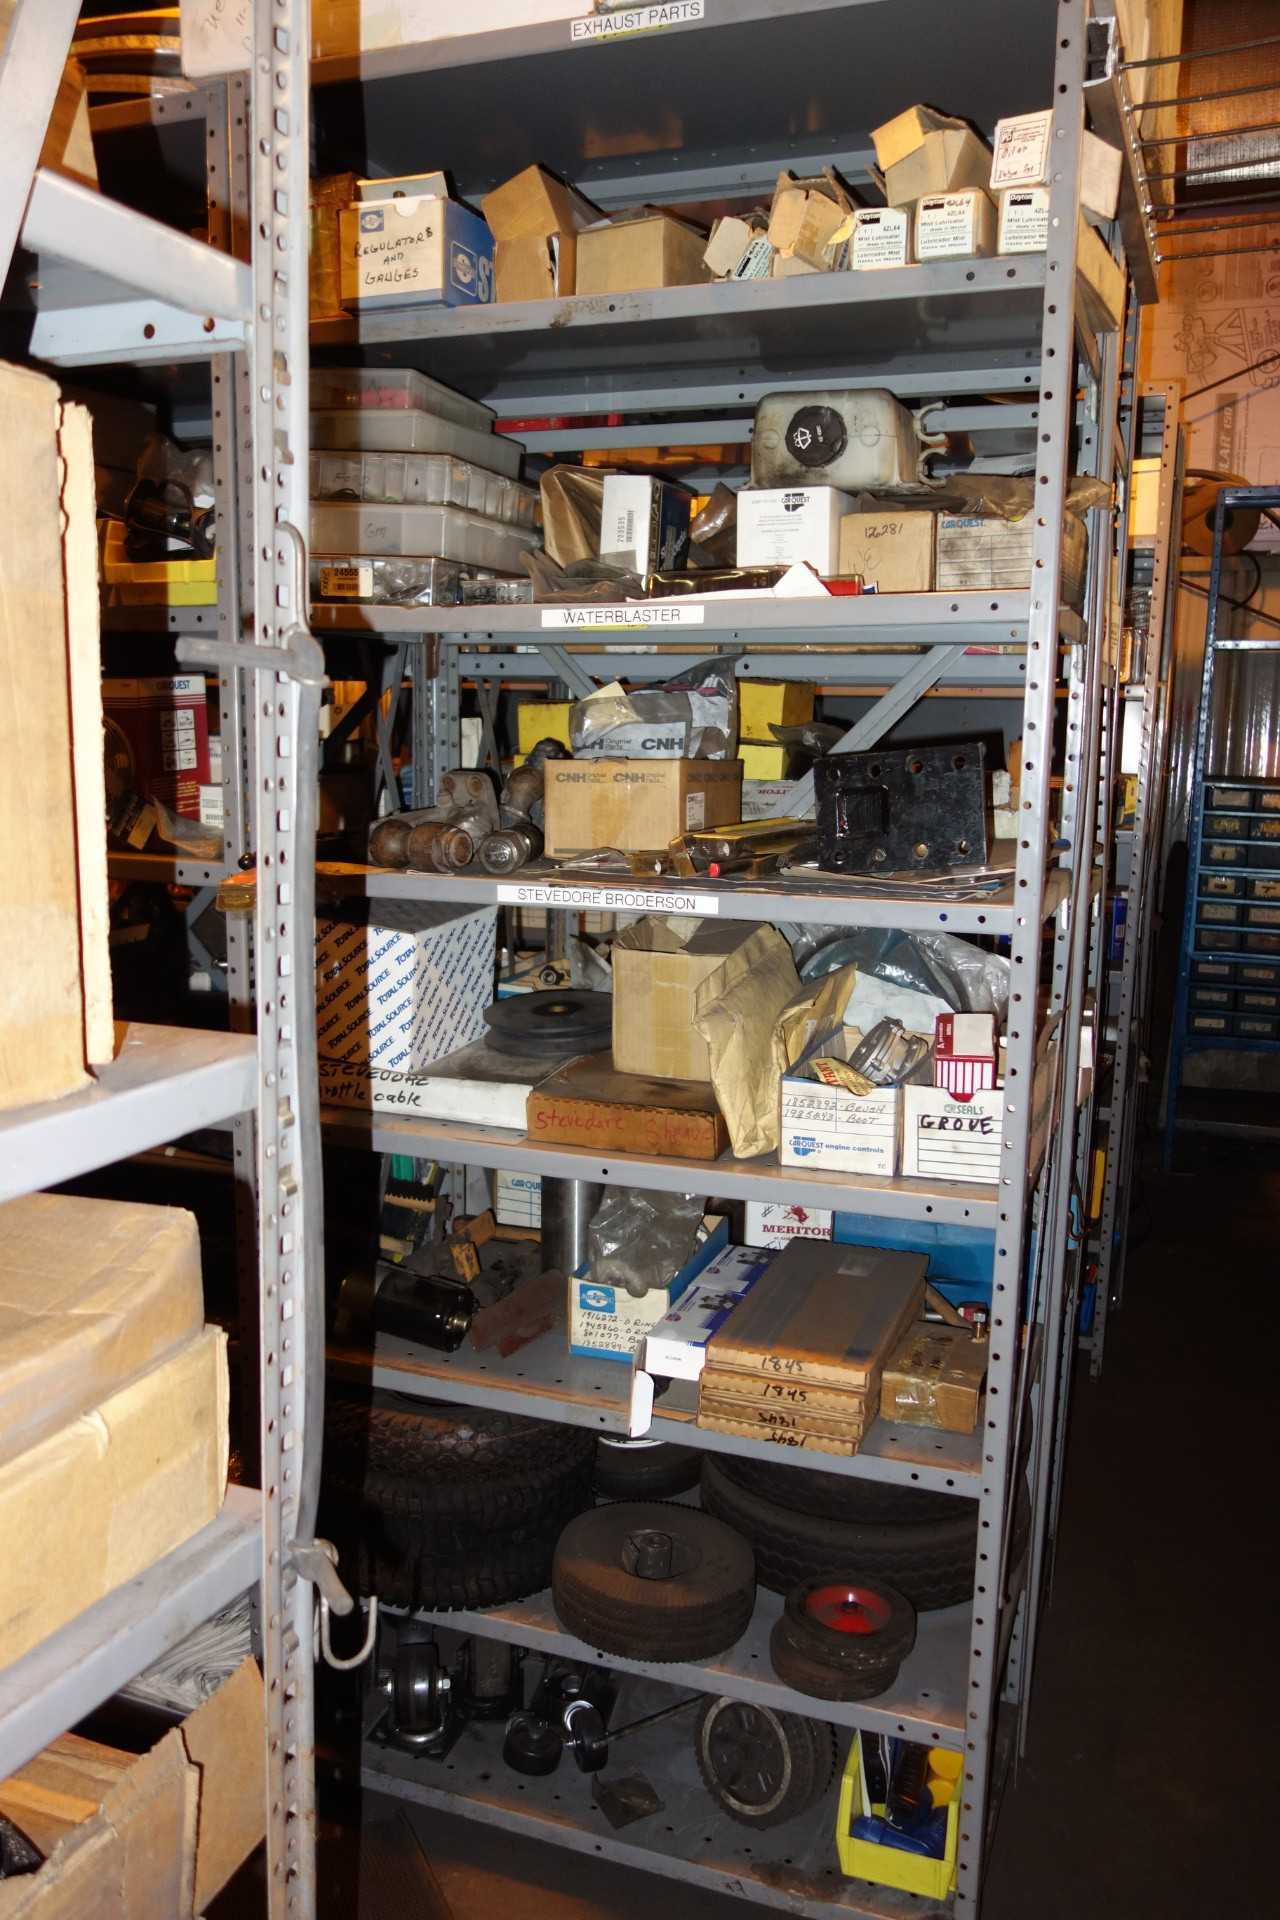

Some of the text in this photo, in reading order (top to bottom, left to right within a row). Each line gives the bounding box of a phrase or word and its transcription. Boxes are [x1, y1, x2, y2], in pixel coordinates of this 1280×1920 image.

[573, 2, 700, 37] EXHAUST PARTS
[384, 252, 404, 265] AND
[365, 268, 419, 285] GAUGES
[564, 608, 681, 624] WATERBLASTER
[641, 737, 684, 750] CNH
[556, 772, 586, 784] CNH
[613, 772, 645, 784] CNH
[518, 888, 696, 910] STEVEDORE BRODERSON
[387, 1047, 410, 1068] TOTAL
[374, 1091, 422, 1107] cable
[957, 1105, 985, 1116] SEALS
[920, 1114, 994, 1135] GROVE
[825, 1143, 850, 1152] engine
[852, 1145, 885, 1154] controls
[762, 1224, 832, 1237] MERITOR
[761, 1357, 803, 1374] 1845
[763, 1383, 808, 1402] 1845
